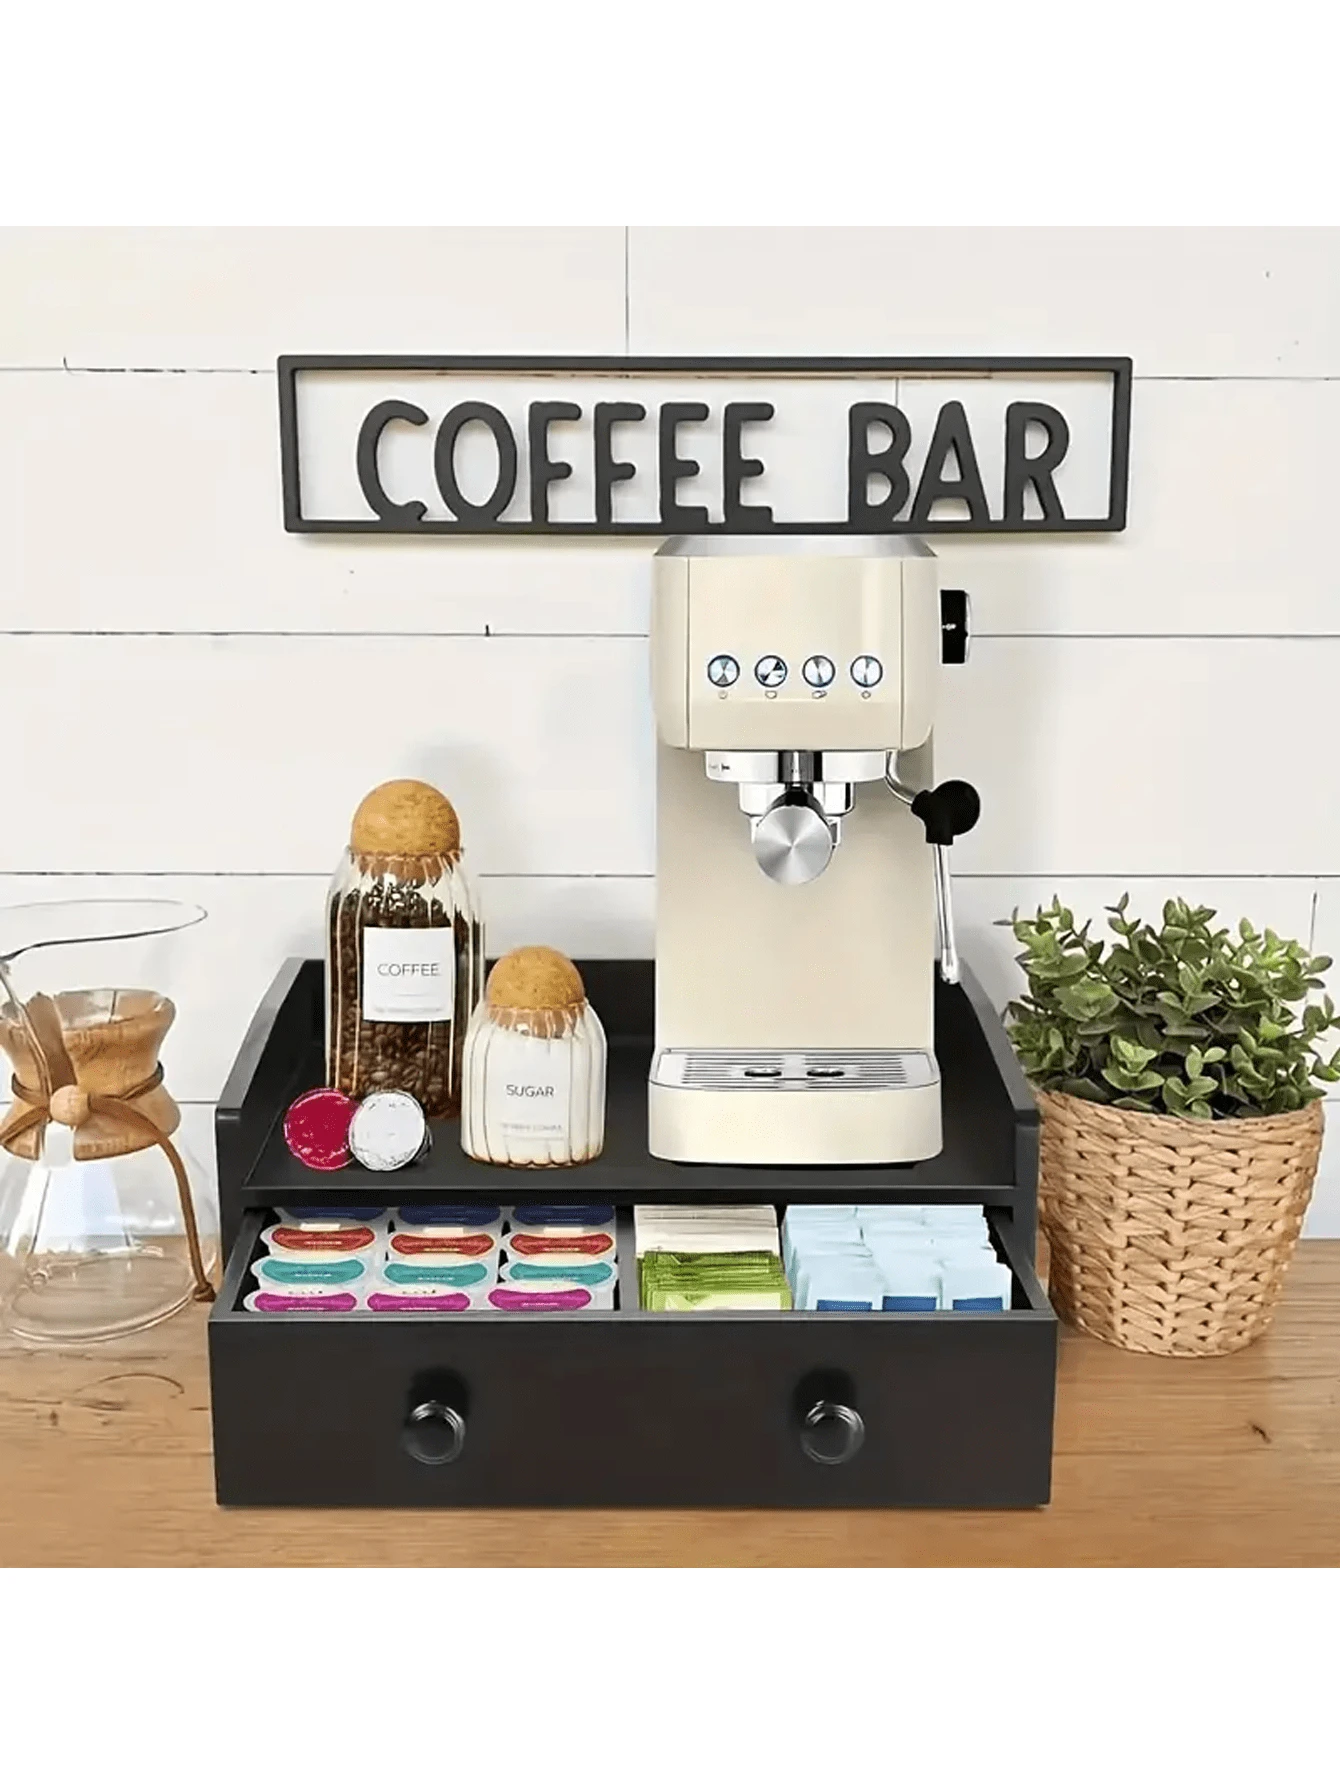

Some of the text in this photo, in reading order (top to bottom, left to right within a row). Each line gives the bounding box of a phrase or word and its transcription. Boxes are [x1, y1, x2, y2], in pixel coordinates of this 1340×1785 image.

[357, 399, 1070, 525] COFFEE BAR
[377, 962, 441, 977] COFFEE
[506, 1084, 555, 1098] SUGAR
